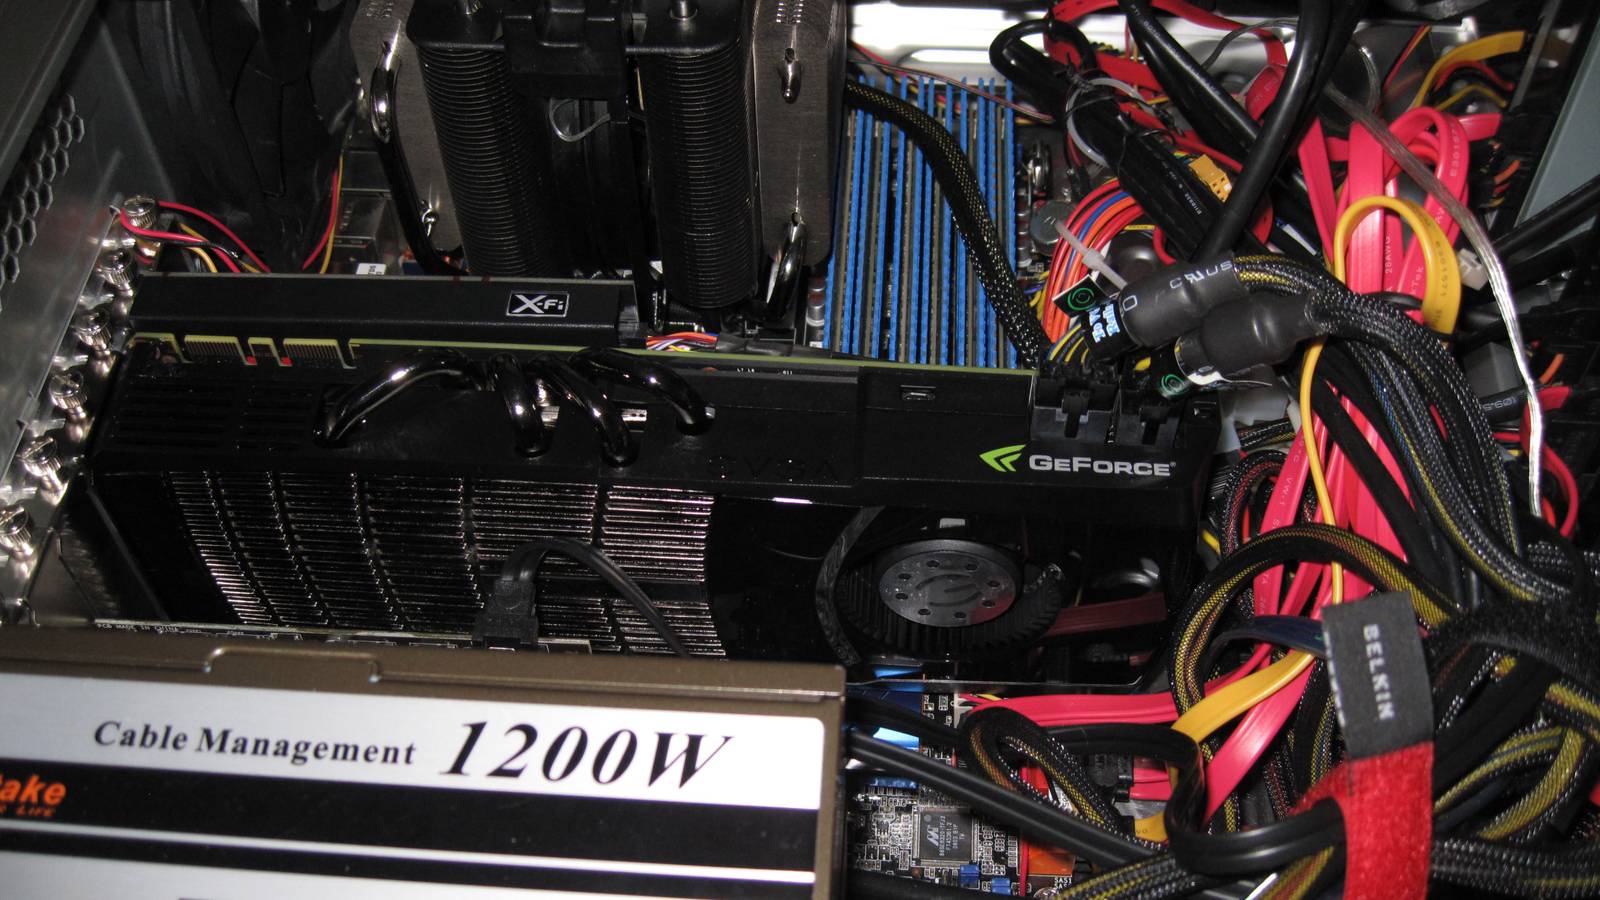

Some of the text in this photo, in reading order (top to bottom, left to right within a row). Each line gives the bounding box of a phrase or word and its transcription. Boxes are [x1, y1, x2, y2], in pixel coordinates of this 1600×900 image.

[511, 293, 564, 314] X-Fi
[1279, 476, 1294, 506] VW-1
[116, 624, 138, 632] MADE
[1363, 623, 1395, 720] BELKIN
[94, 720, 417, 766] Cable Management
[438, 721, 733, 790] 1200W
